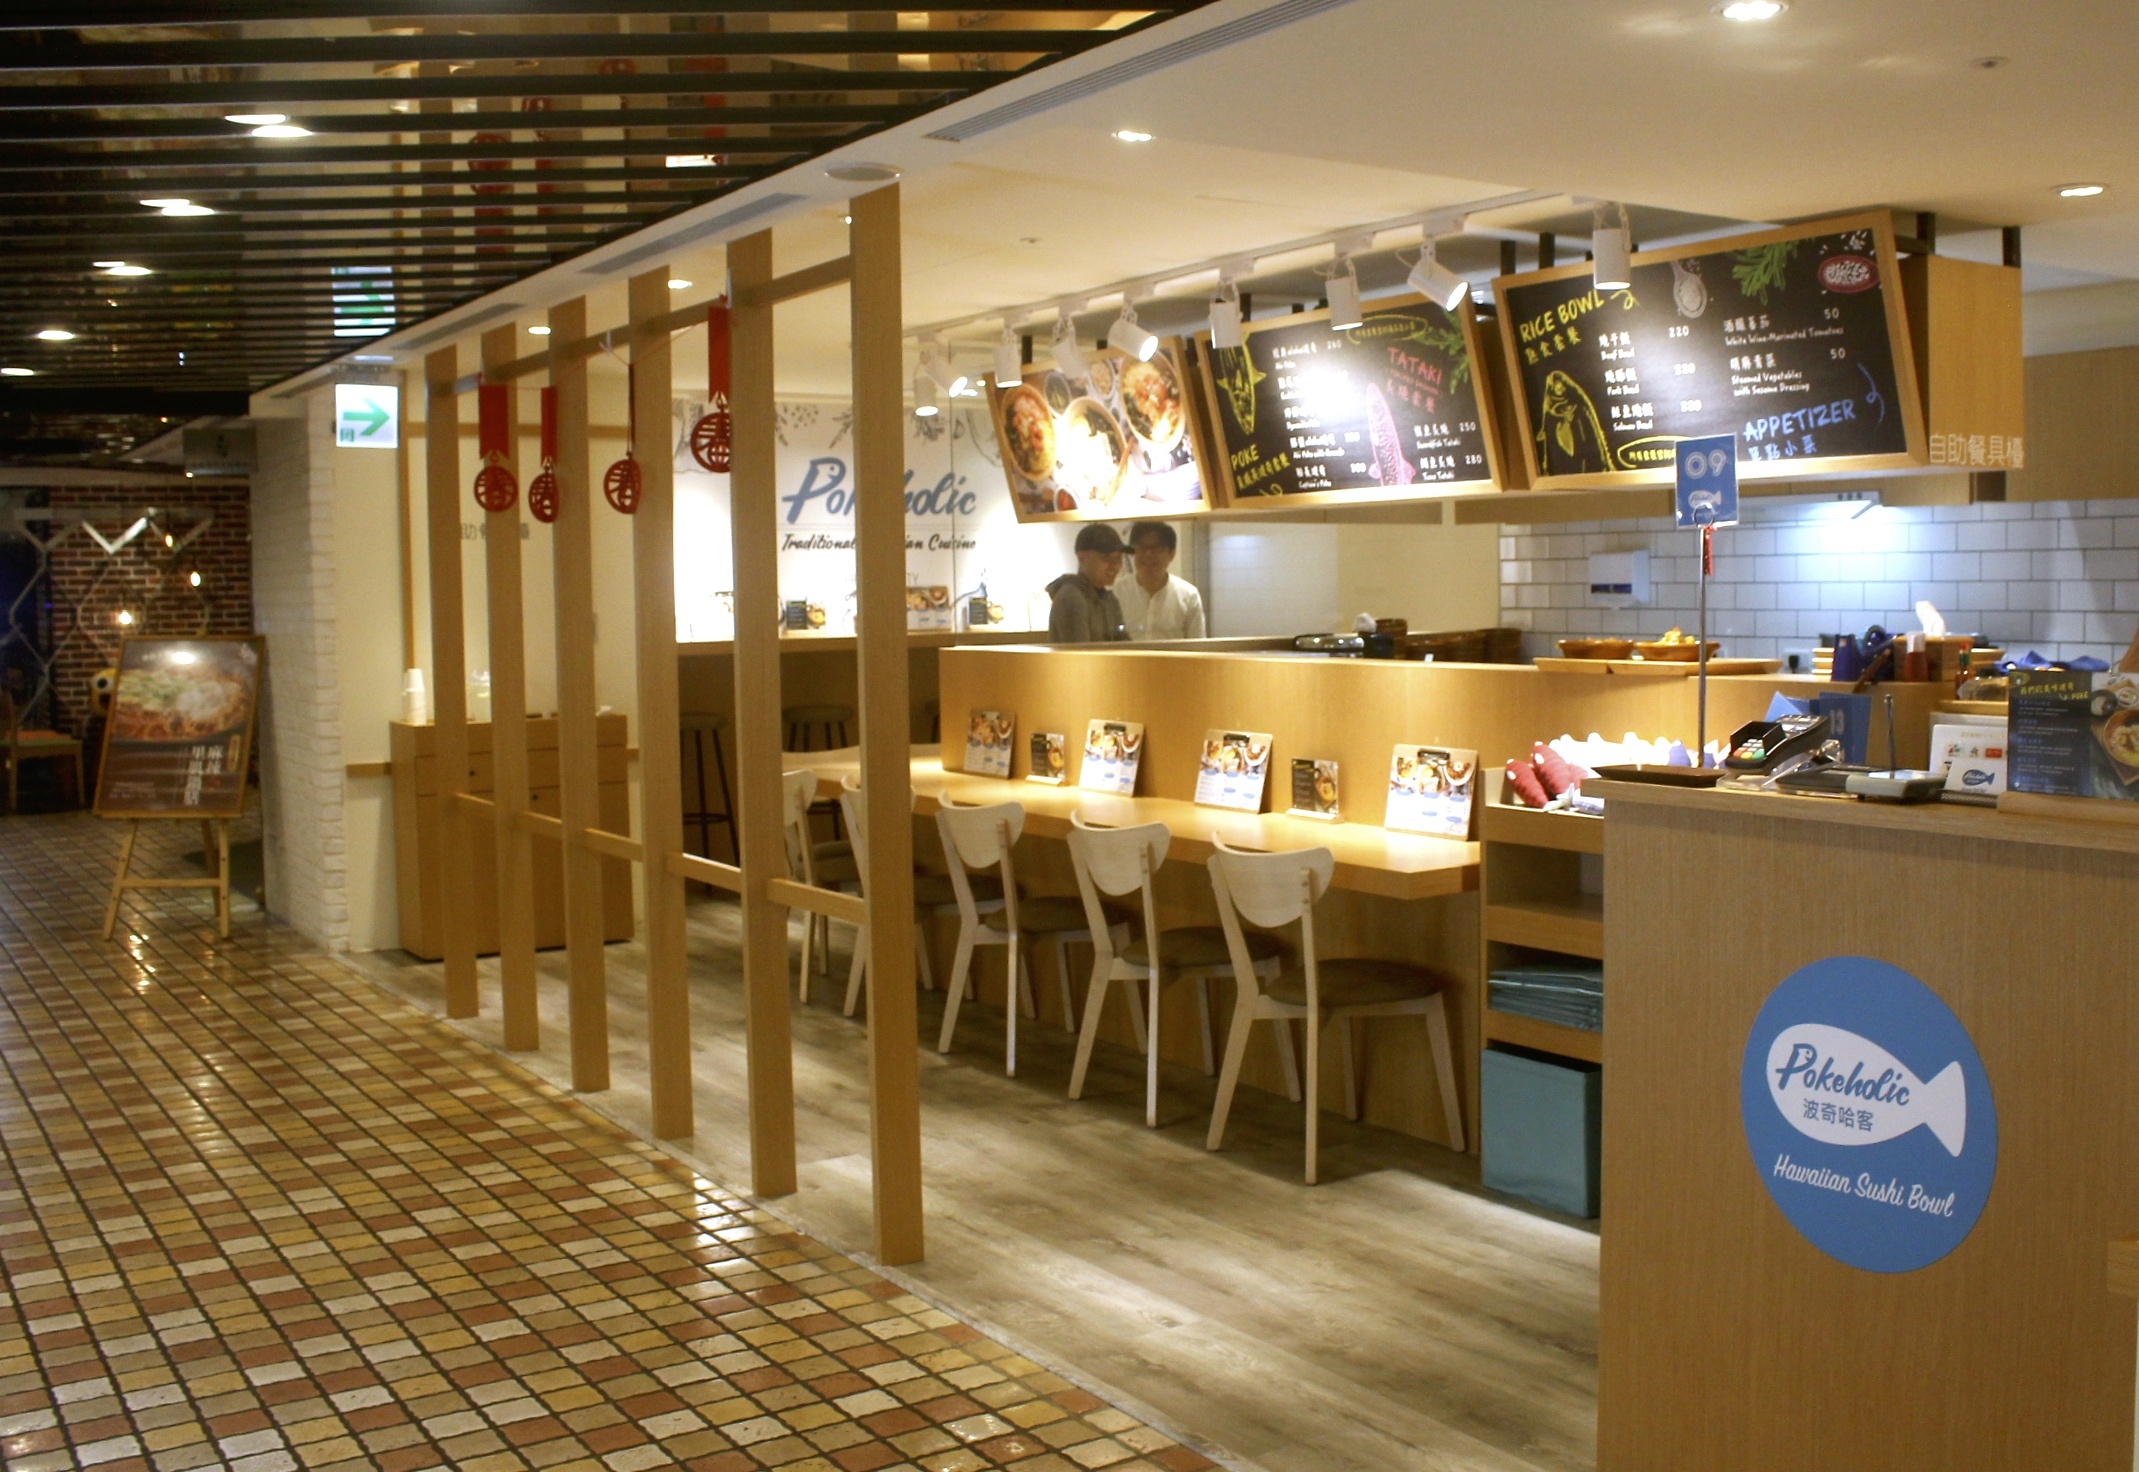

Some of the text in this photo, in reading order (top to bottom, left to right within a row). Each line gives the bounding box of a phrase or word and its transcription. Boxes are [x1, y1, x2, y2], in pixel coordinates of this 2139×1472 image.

[1519, 289, 1605, 343] RICE BOWL
[1824, 308, 1840, 320] 50
[1668, 325, 1690, 338] 220
[1388, 346, 1443, 385] TATAKI
[1830, 348, 1846, 360] 50
[1742, 398, 1856, 442] APPETIZER
[1231, 444, 1259, 470] POKE
[1684, 449, 1727, 479] 09
[782, 456, 978, 524] Poolic
[782, 534, 856, 551] Traditional
[928, 533, 976, 551] Cuisine
[1775, 1043, 1910, 1106] Pokeholic
[1803, 1098, 1874, 1132] 波奇哈客
[1773, 1154, 1955, 1217] Hawaiian Sushi Bowl
